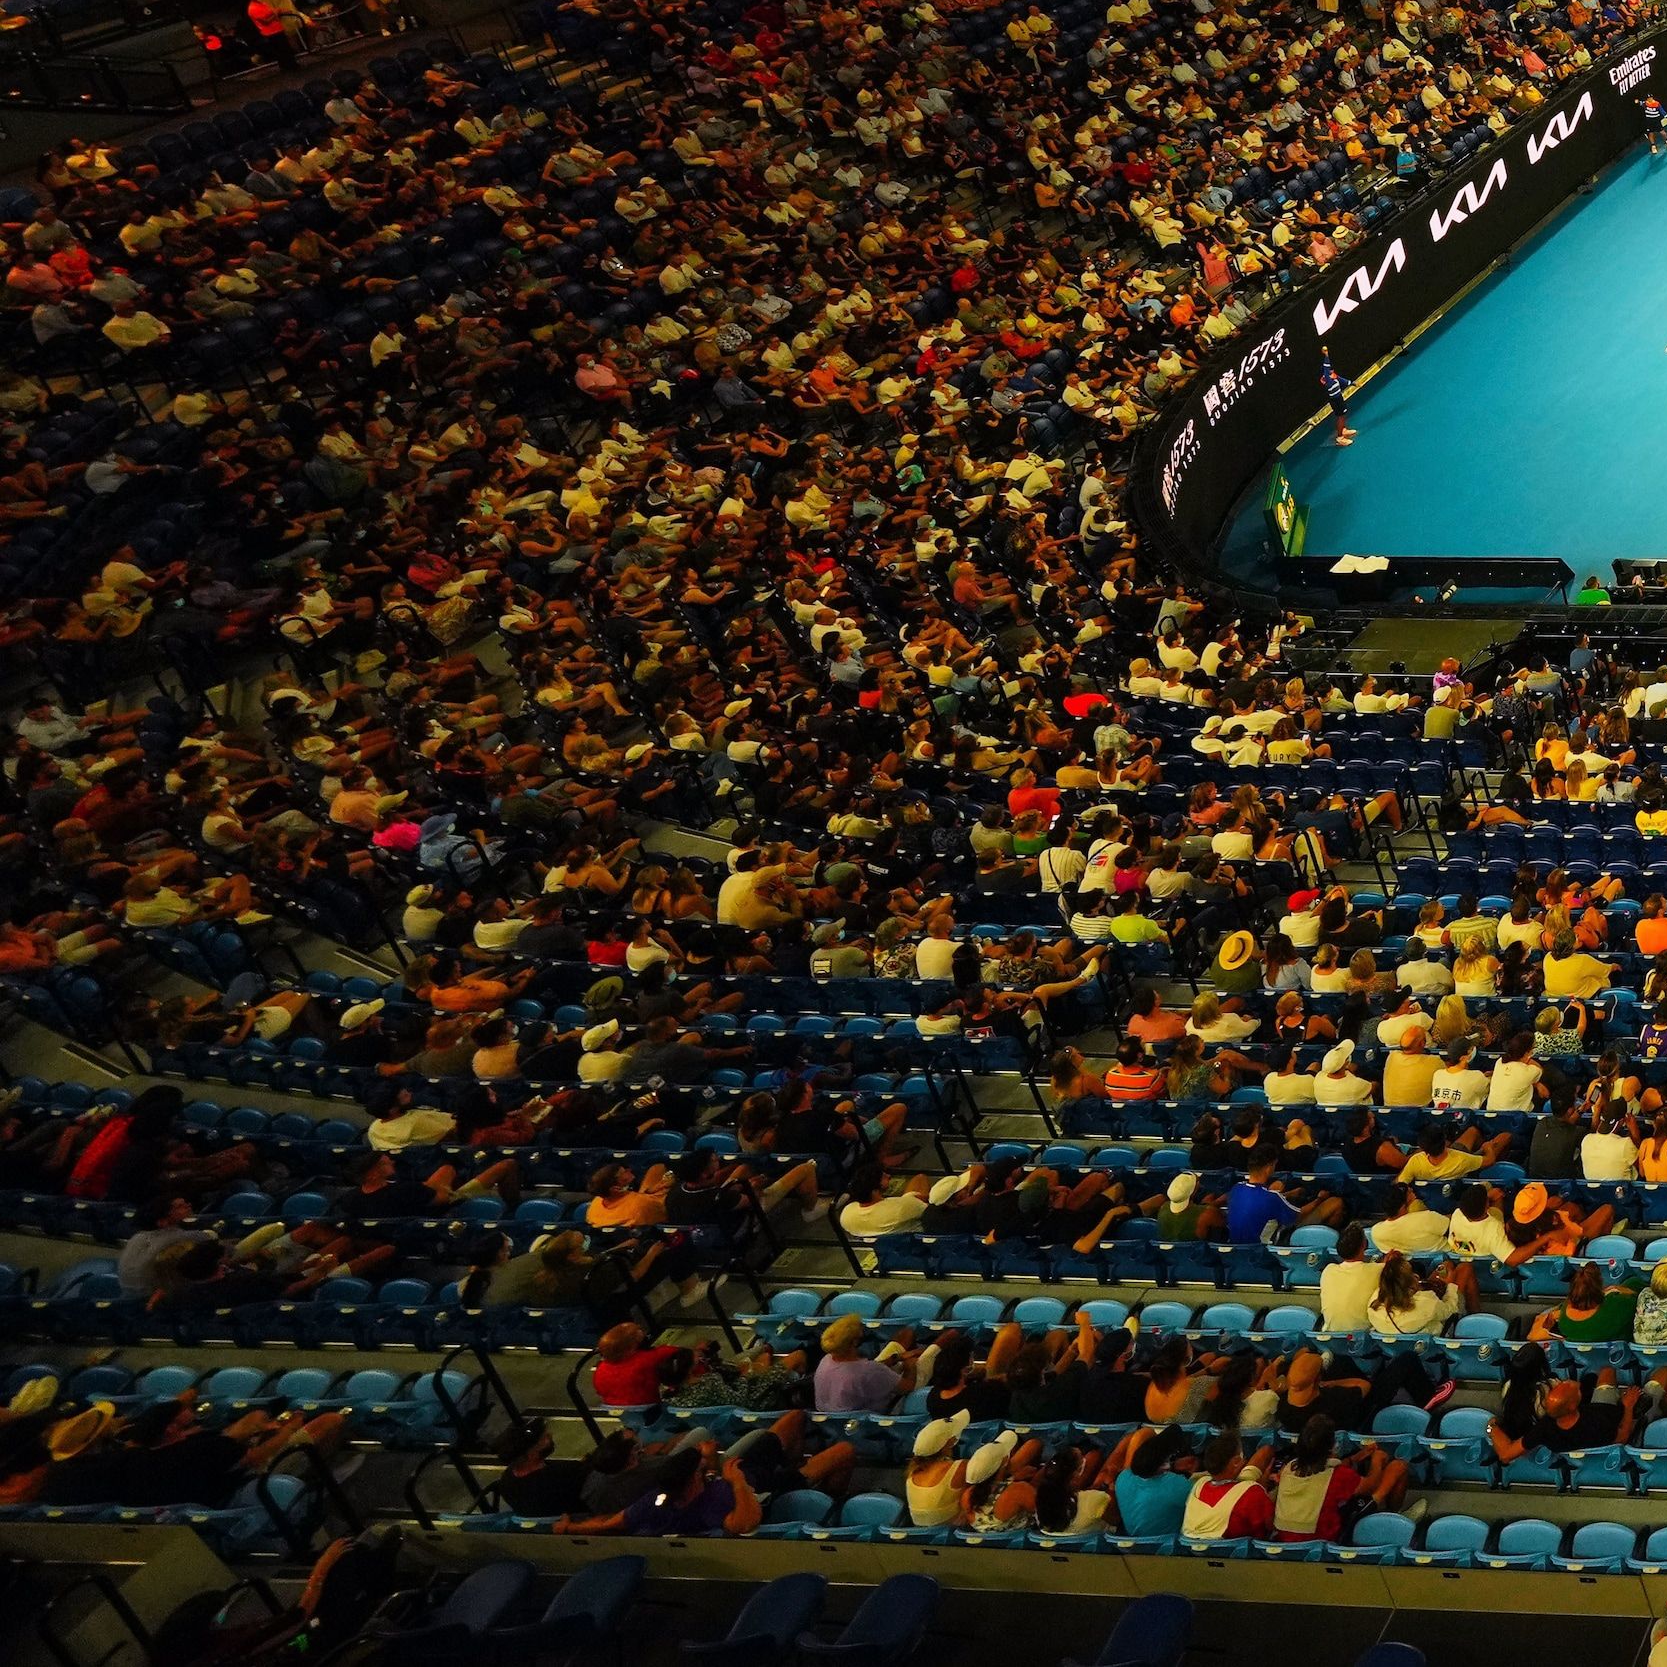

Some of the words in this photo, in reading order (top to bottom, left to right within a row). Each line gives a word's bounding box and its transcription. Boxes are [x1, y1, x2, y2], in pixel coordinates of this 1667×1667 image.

[1609, 45, 1656, 85] Emirates
[1619, 78, 1629, 96] FLY
[1628, 63, 1651, 90] BETTER
[1527, 91, 1593, 164] KIA
[1429, 158, 1507, 242] KIA
[1312, 238, 1406, 335] KIA
